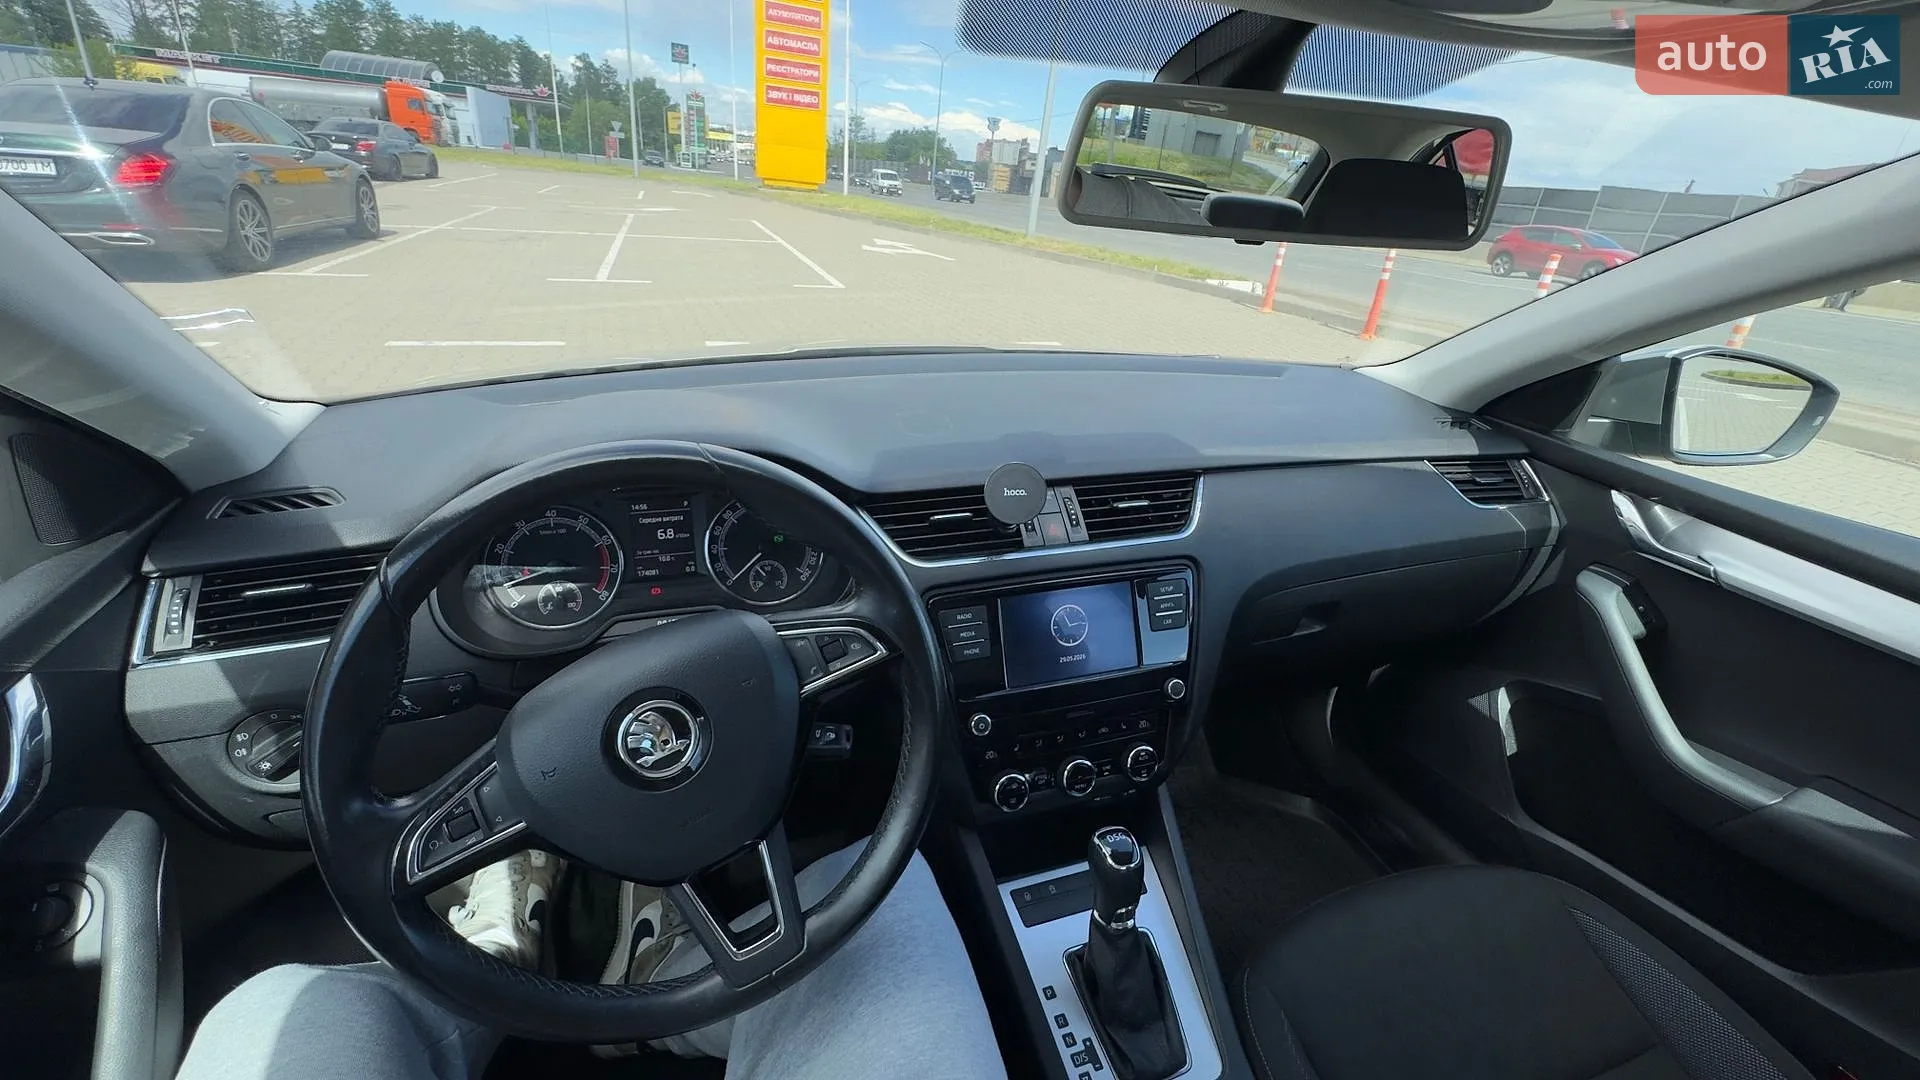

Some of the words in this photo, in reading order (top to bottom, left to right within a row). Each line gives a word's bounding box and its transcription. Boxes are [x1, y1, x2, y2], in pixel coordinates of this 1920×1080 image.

[767, 36, 819, 52] АВТОМАСЛА
[767, 90, 787, 100] ЗВУК
[793, 93, 819, 104] ВІДЕО
[1003, 487, 1028, 497] hoco.
[545, 510, 557, 518] 40
[515, 519, 526, 530] 30
[578, 515, 590, 525] 50
[601, 534, 612, 546] 60
[494, 543, 505, 554] 20
[610, 563, 619, 573] 70
[800, 568, 812, 581] 260
[598, 590, 609, 601] 80
[1106, 832, 1126, 843] DSG
[1073, 1053, 1089, 1065] D/S
